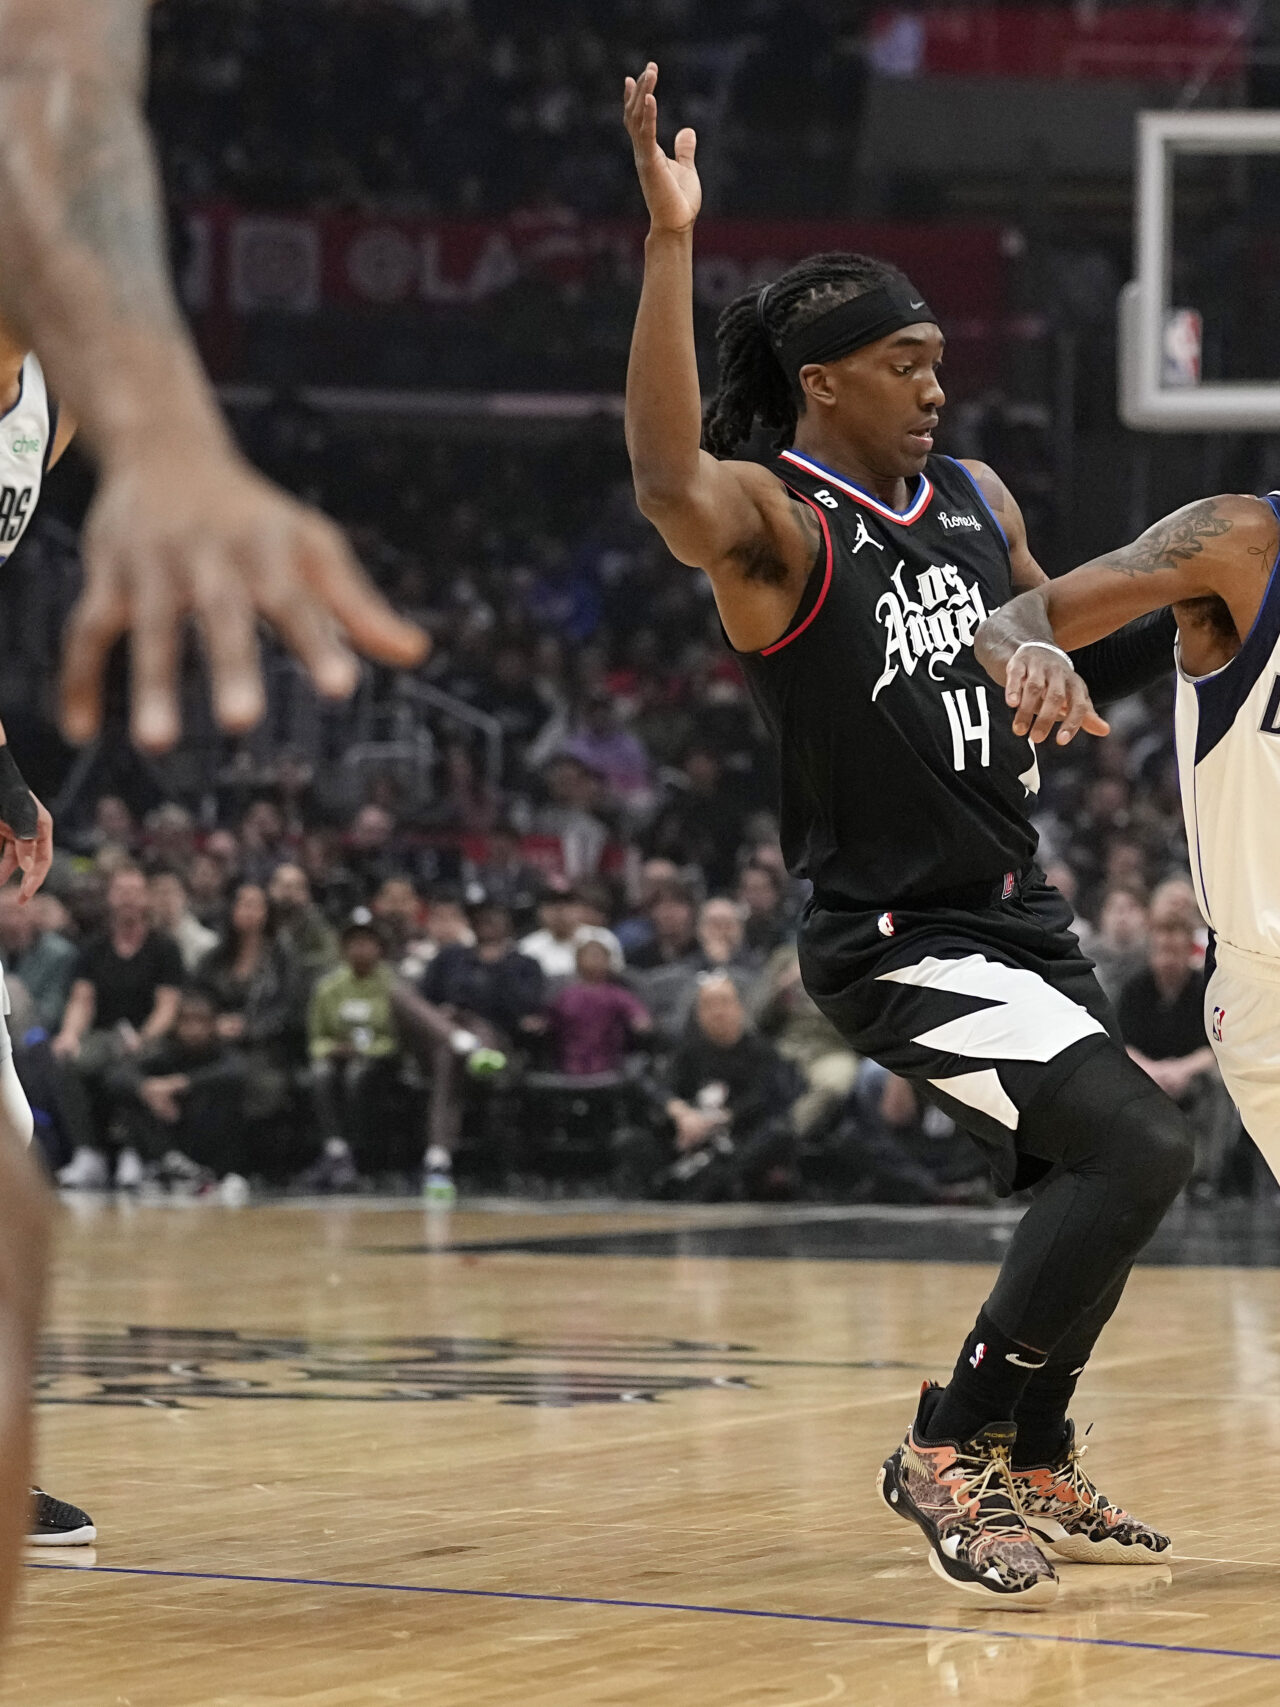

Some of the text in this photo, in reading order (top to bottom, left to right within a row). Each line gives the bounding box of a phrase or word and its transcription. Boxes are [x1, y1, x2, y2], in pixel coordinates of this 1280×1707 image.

[814, 489, 839, 509] 6
[937, 511, 982, 531] honey
[889, 559, 971, 619] Los
[871, 581, 1000, 702] Angel
[941, 686, 990, 770] 14
